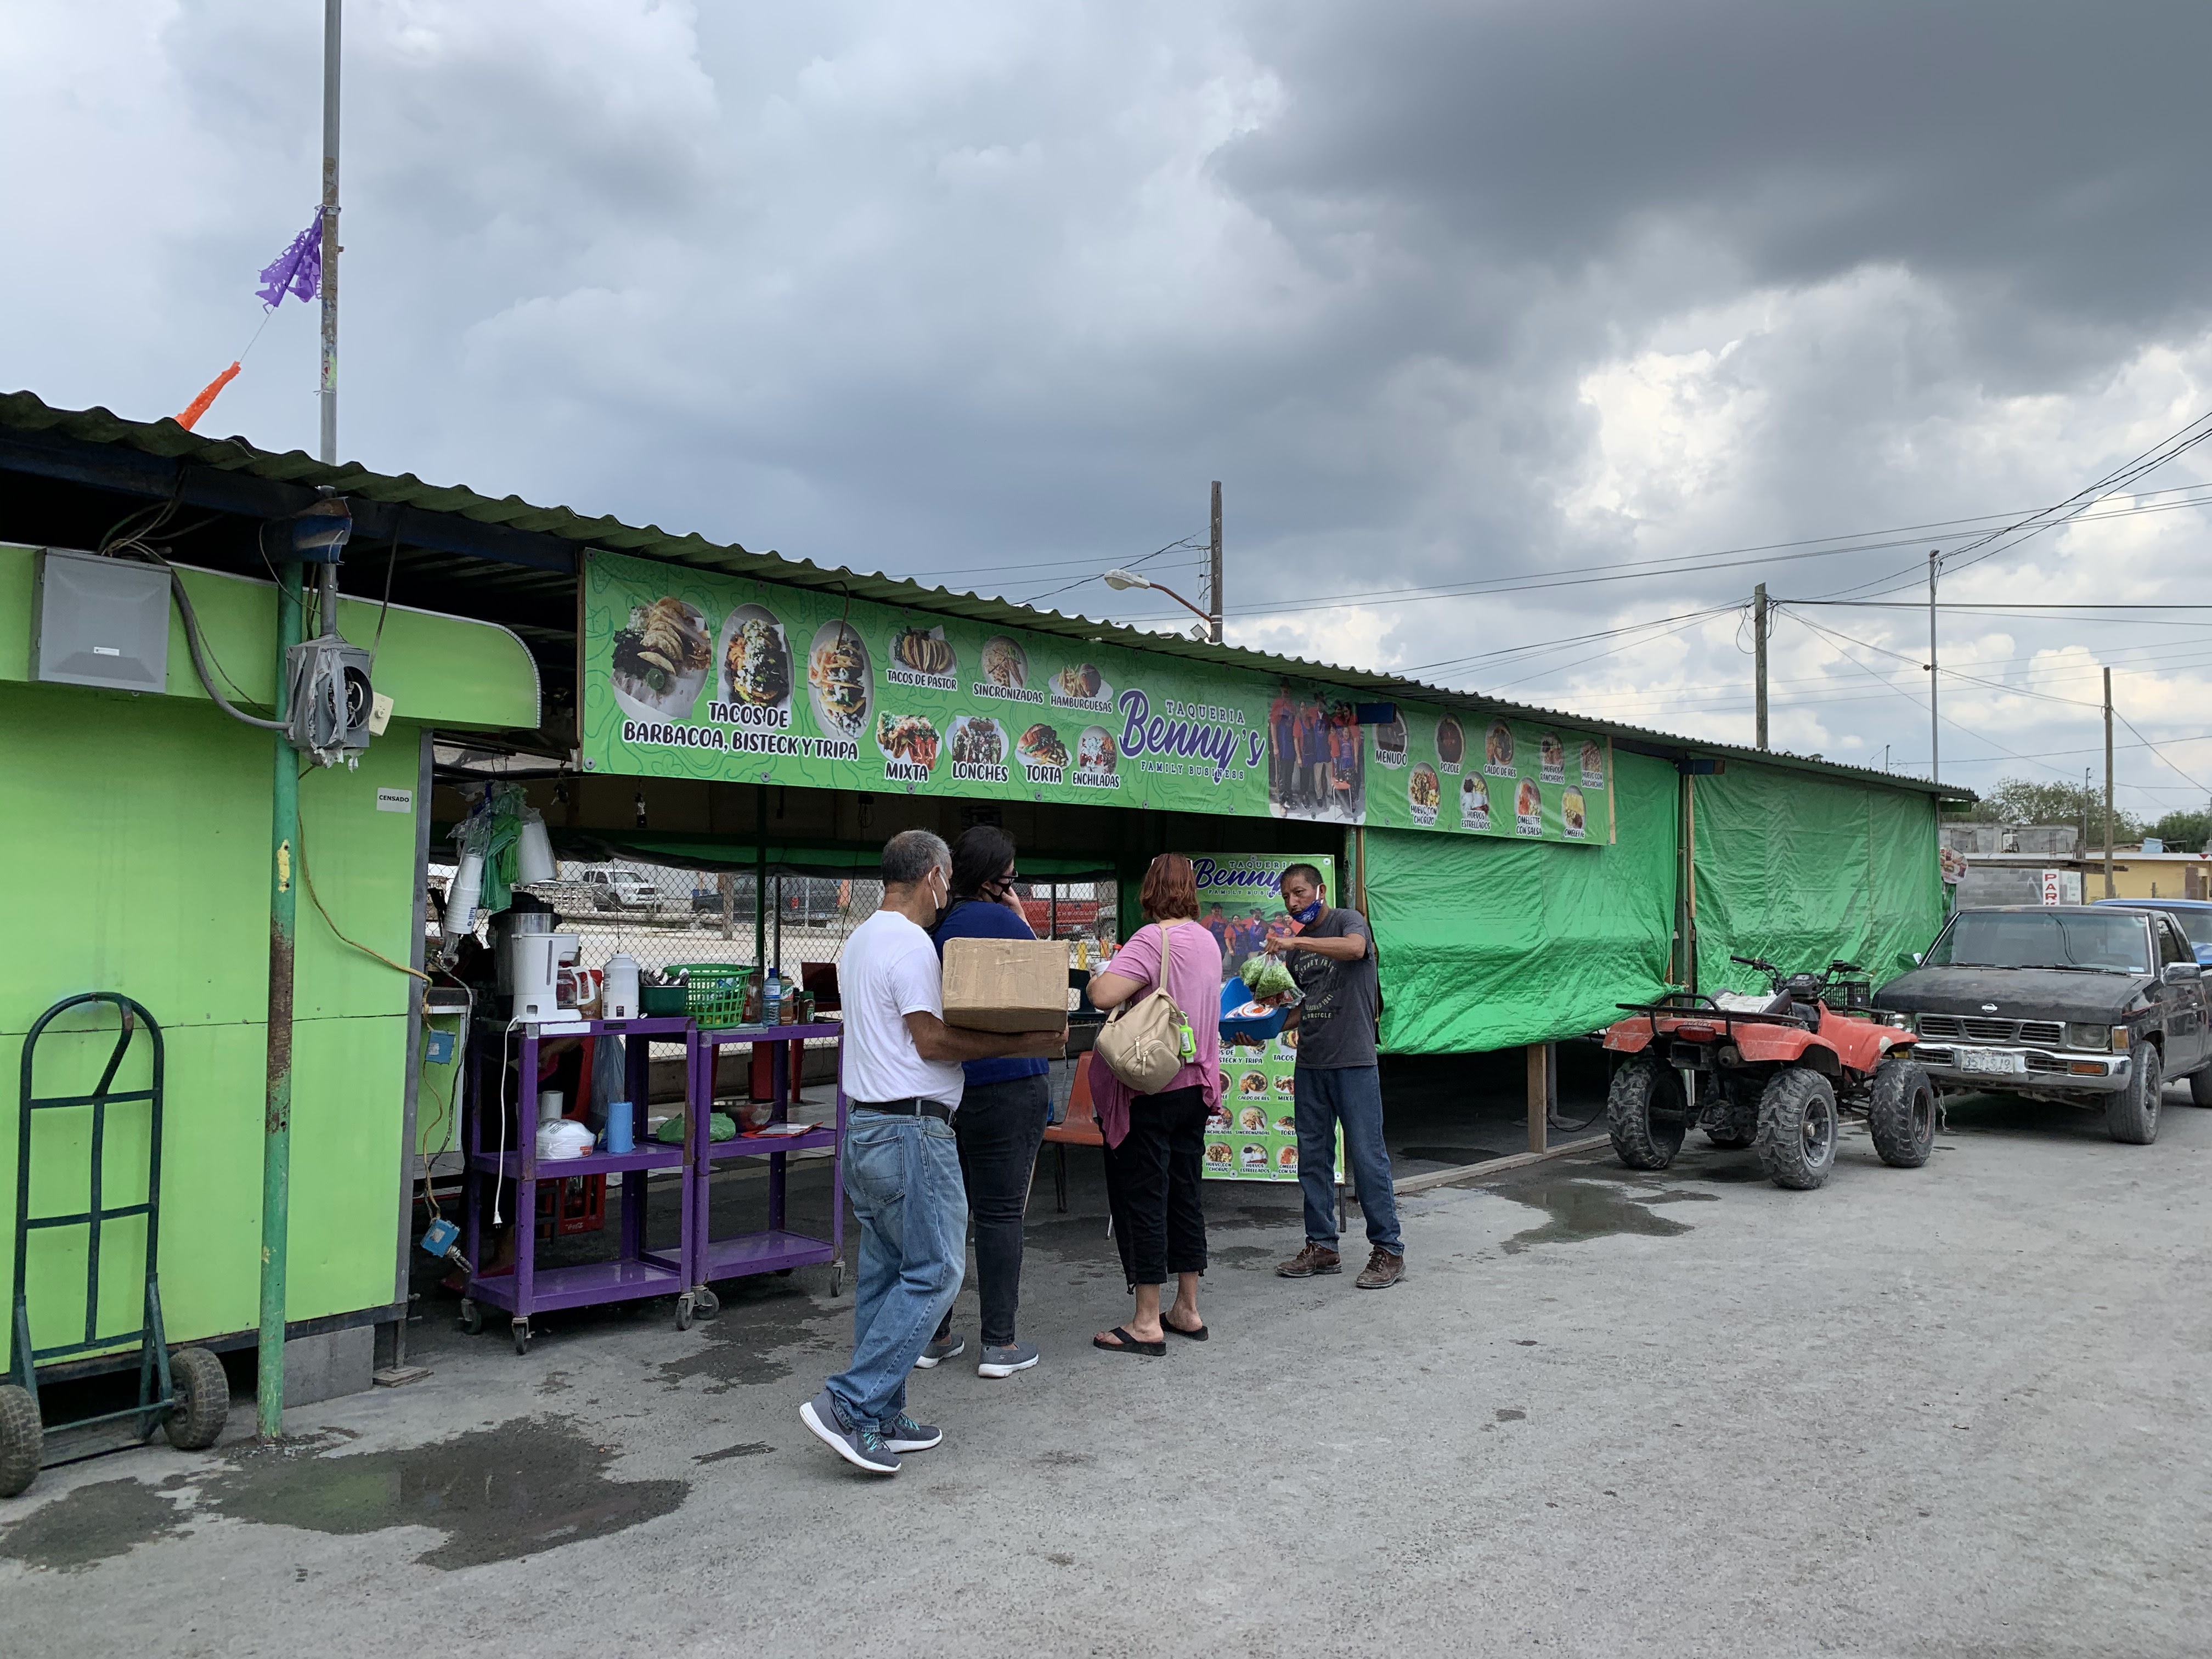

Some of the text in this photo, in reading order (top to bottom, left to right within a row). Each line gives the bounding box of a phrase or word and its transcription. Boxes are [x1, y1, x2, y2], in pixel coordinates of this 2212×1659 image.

[887, 670, 957, 690] TACOS DE PASTOR
[974, 684, 1043, 704] SINCRONIZADAS
[1051, 695, 1113, 713] HAMBURGUESAS
[708, 703, 788, 727] TACOS DE
[1167, 702, 1244, 723] TAQUERIA
[624, 723, 859, 760] BARBACOA, BISTECK Y TRIPA
[1119, 690, 1265, 783] Benny's
[1375, 750, 1407, 766] MENUDO
[886, 763, 928, 781] MIXTA
[952, 762, 1008, 782] LONCHES
[1026, 766, 1062, 783] TORTA
[1141, 761, 1244, 780] FAMILY BUSINESS
[1440, 763, 1460, 774] POZOLE
[1484, 765, 1516, 777] CALDO DE RES
[1544, 765, 1560, 774] HUEVOS
[1073, 772, 1120, 788] ENCHILADAS
[1540, 773, 1564, 783] RANCHEROS
[1582, 780, 1604, 789] SALCHICHAS
[1410, 806, 1437, 816] HUEVO CON
[1467, 811, 1485, 820] HUEVOS
[1414, 816, 1435, 825] CHORIZO
[1461, 820, 1491, 830] ESTRELLADOS
[1517, 816, 1541, 826] OMELETTE
[1516, 826, 1542, 836] CON SALSA
[1564, 829, 1585, 838] OMELETTE
